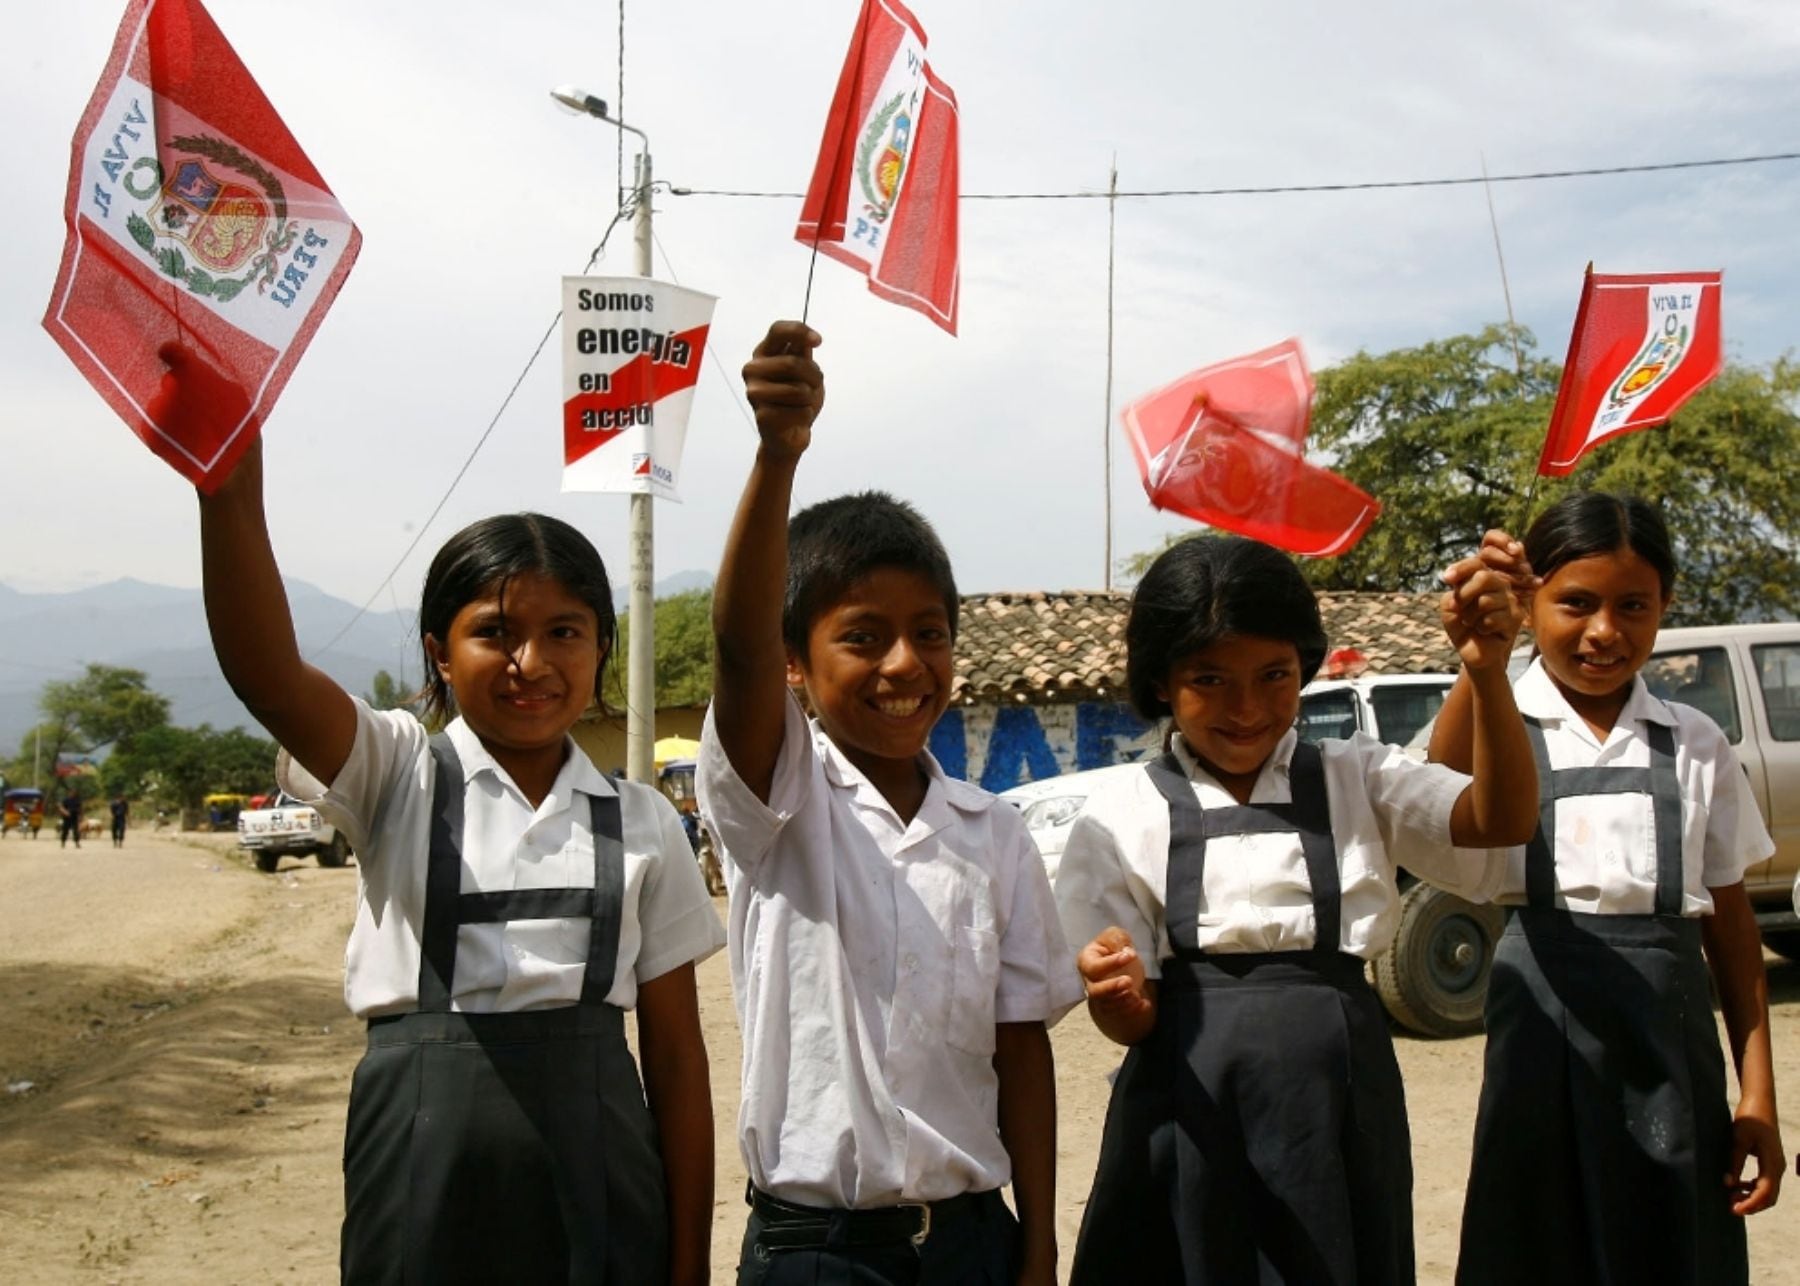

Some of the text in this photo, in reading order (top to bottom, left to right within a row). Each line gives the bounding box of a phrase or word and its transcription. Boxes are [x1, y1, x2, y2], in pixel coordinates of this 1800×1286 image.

[578, 288, 653, 312] Somos
[577, 327, 690, 366] energía
[579, 372, 609, 392] en
